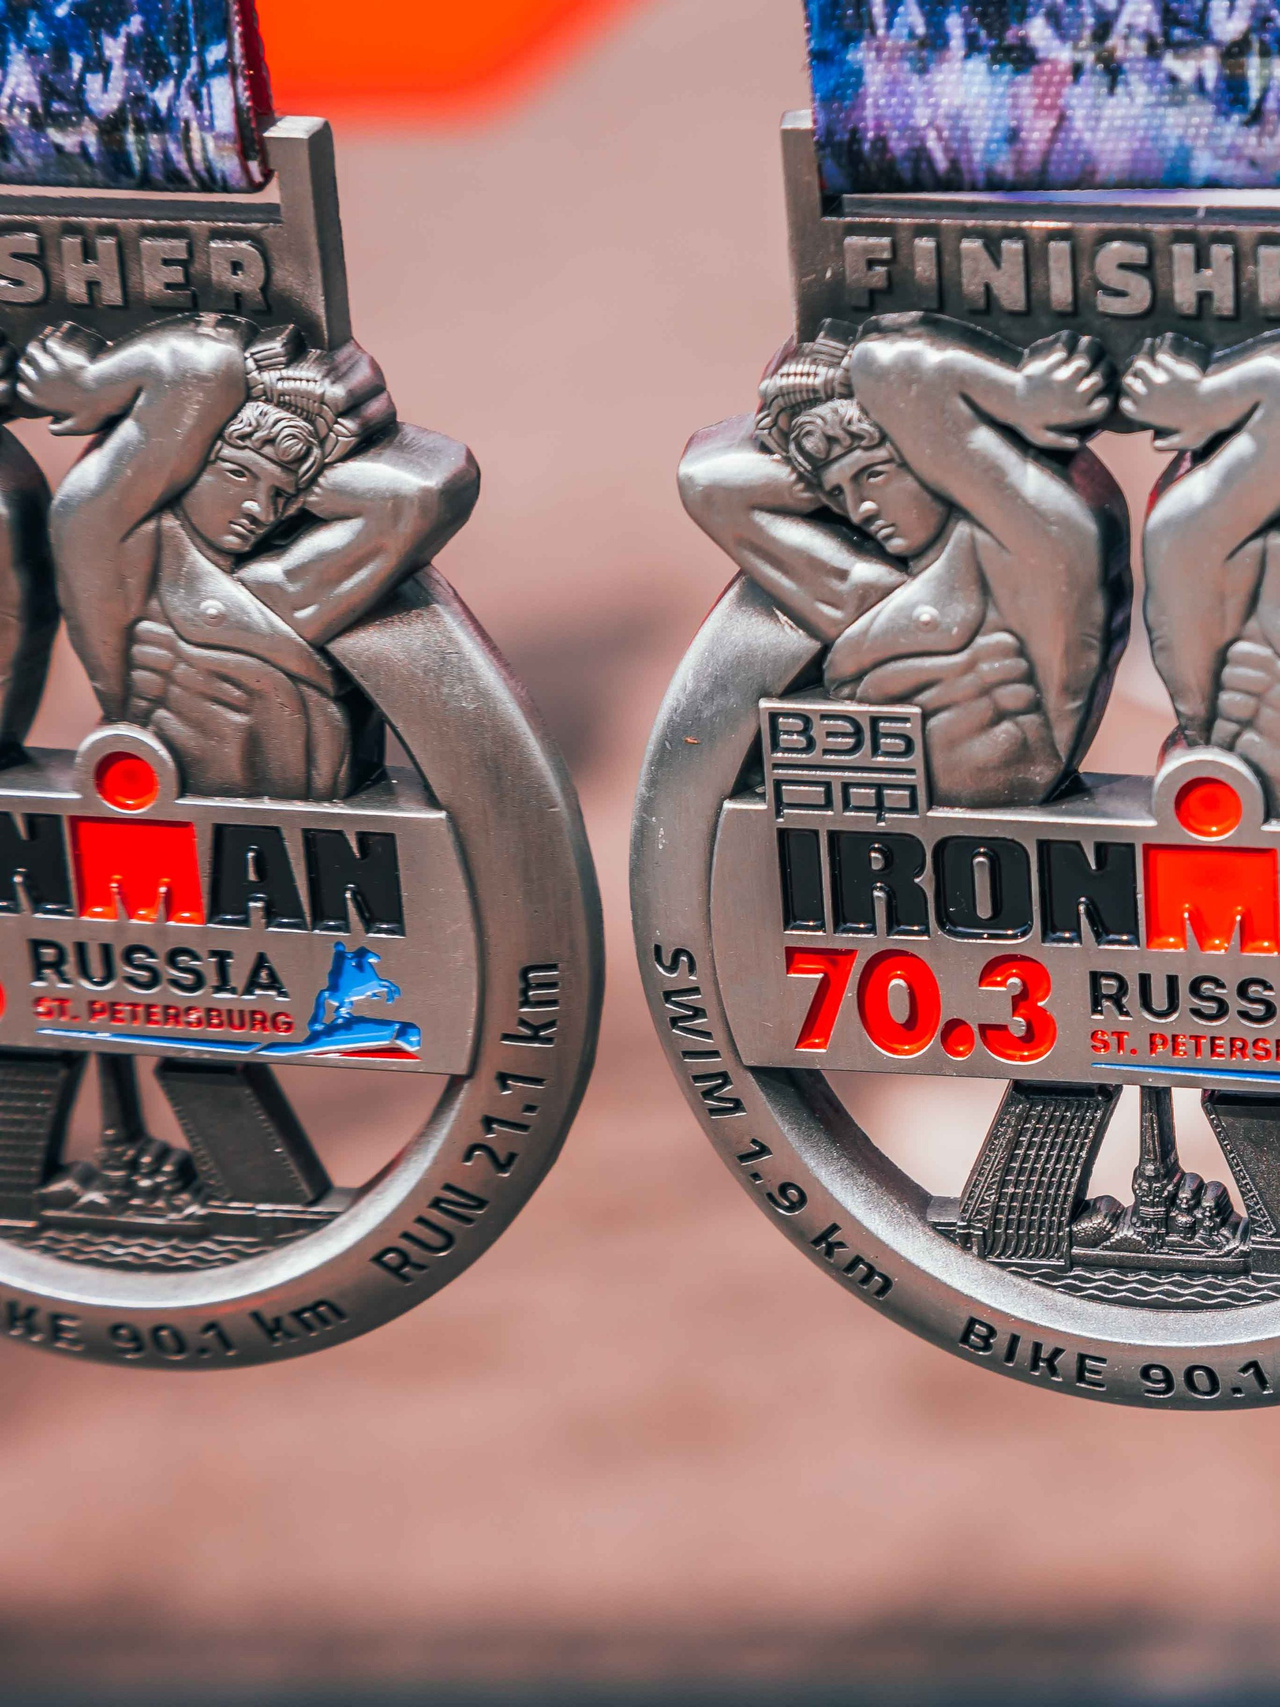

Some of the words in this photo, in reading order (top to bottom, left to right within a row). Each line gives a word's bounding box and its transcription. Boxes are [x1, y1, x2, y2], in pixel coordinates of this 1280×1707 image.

[0, 232, 270, 311] SHER
[769, 711, 915, 761] ВЭБ
[28, 937, 291, 1000] RUSSIA
[501, 961, 560, 1048] km
[784, 946, 1058, 1065] 70.3
[32, 996, 82, 1023] ST.
[88, 1000, 294, 1036] PETERSBURG
[1090, 1030, 1138, 1057] ST.
[462, 1074, 546, 1177] 21.1
[654, 944, 747, 1120] SWIM
[735, 1138, 809, 1217] 1.9
[810, 1223, 894, 1299] km
[370, 1184, 490, 1285] RUN
[108, 1321, 234, 1360] 90.1
[249, 1299, 349, 1347] km
[959, 1316, 1107, 1391] BIKE
[1139, 1359, 1274, 1400] 90.1
